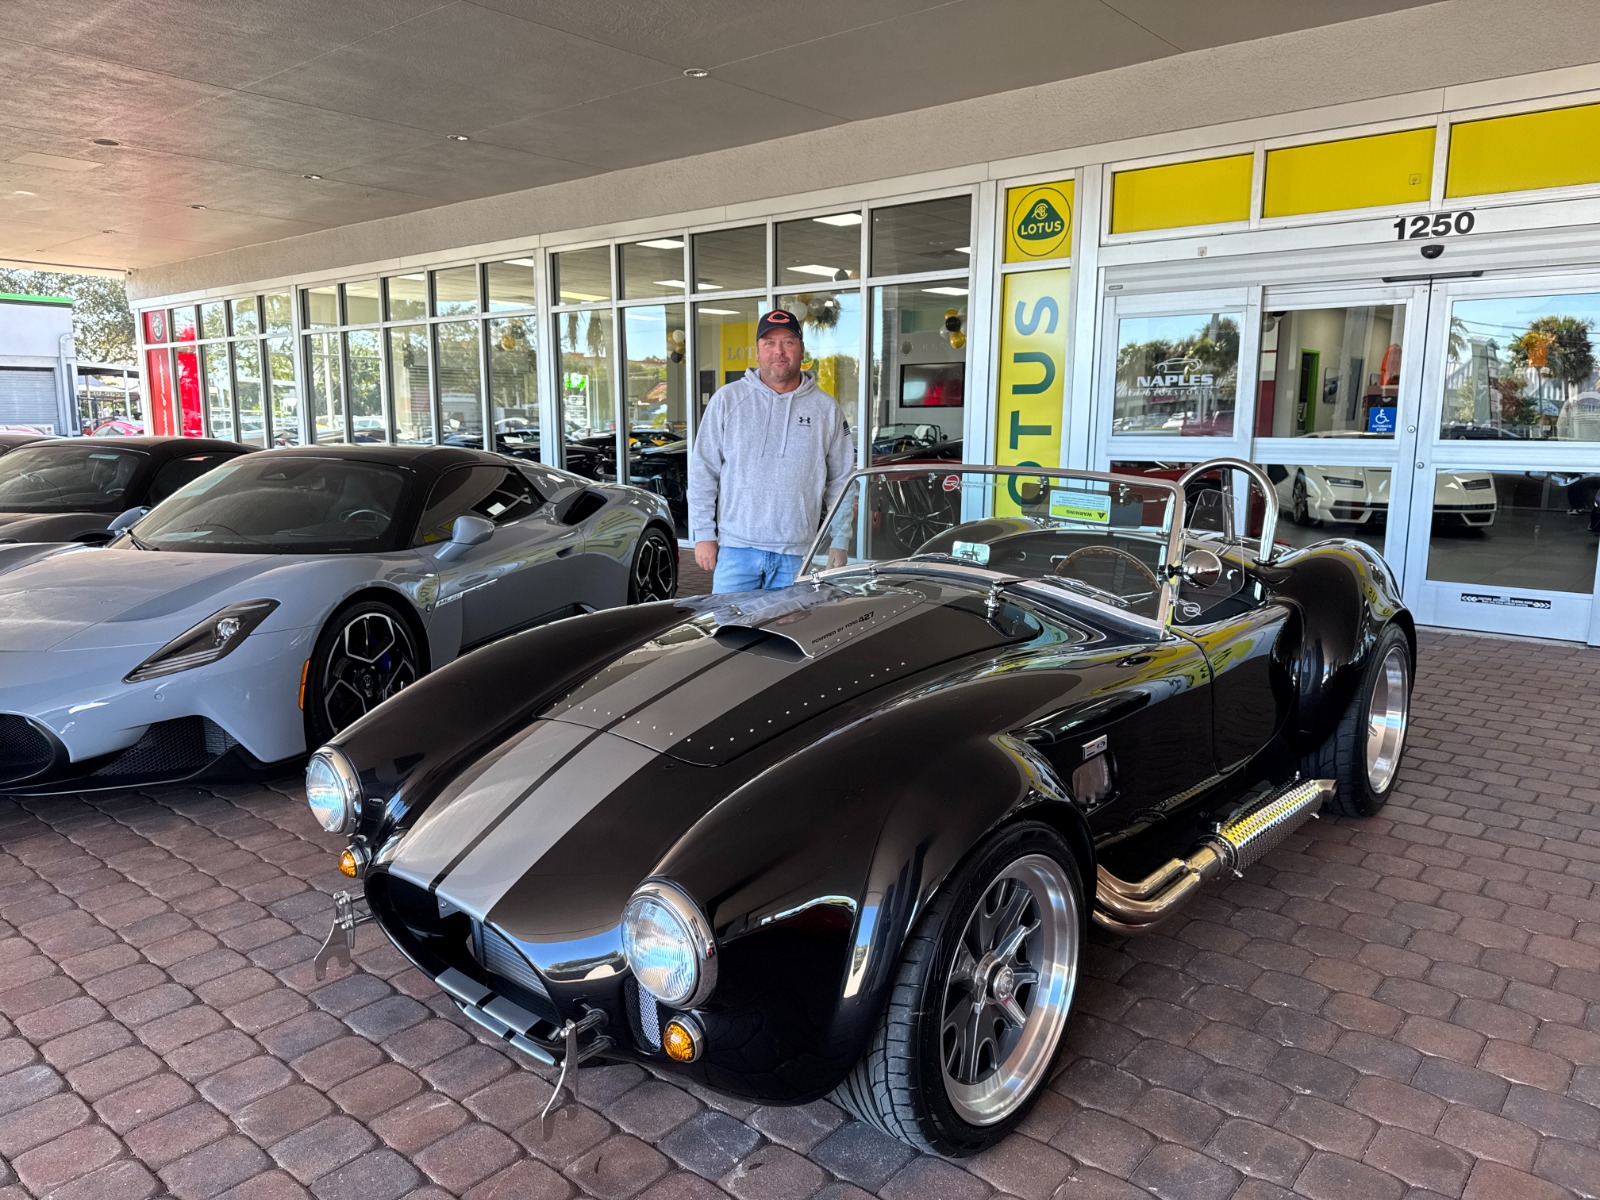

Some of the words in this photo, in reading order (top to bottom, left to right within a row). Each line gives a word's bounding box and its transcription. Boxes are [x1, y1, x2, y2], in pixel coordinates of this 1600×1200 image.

[1020, 220, 1062, 236] LOTUS
[1393, 211, 1475, 240] 1250
[727, 346, 756, 361] LOT
[1136, 374, 1214, 388] NAPLES
[1008, 296, 1059, 508] OTUS
[811, 630, 836, 644] POWERED
[845, 619, 859, 629] FORD
[858, 611, 875, 623] 427
